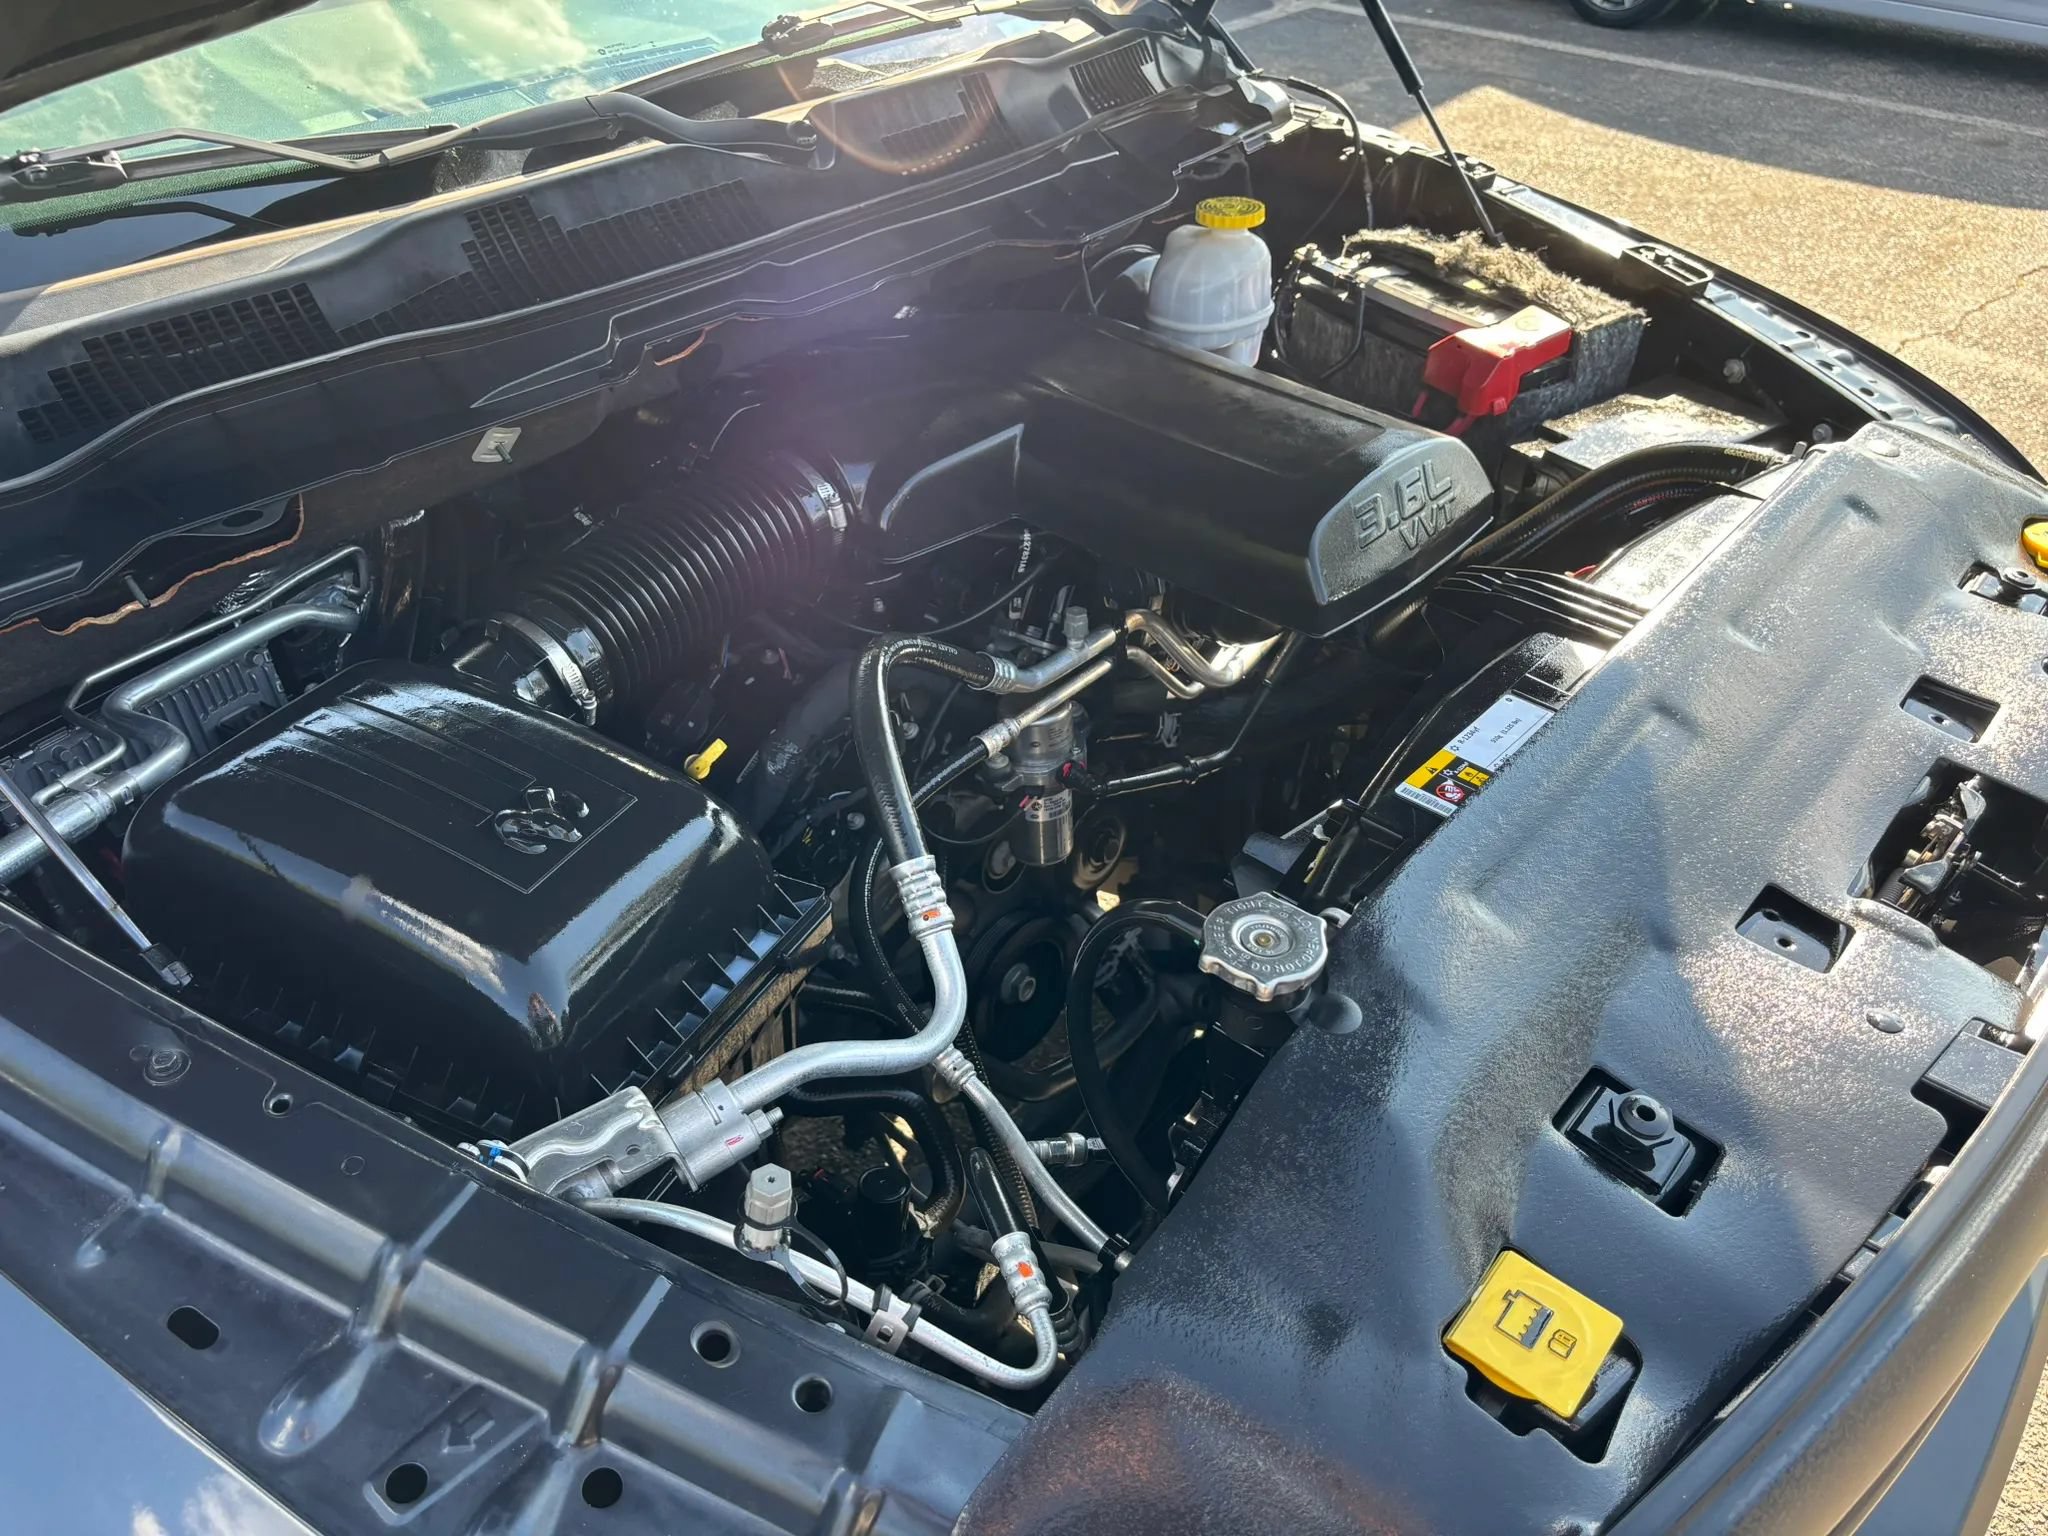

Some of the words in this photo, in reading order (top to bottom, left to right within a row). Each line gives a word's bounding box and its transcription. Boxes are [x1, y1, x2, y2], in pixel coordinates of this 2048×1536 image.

[1353, 459, 1453, 550] 3.6L
[1399, 492, 1457, 551] VVT
[1225, 899, 1266, 914] TIGHT
[1275, 960, 1302, 973] NOT
[1301, 936, 1320, 962] OPEN
